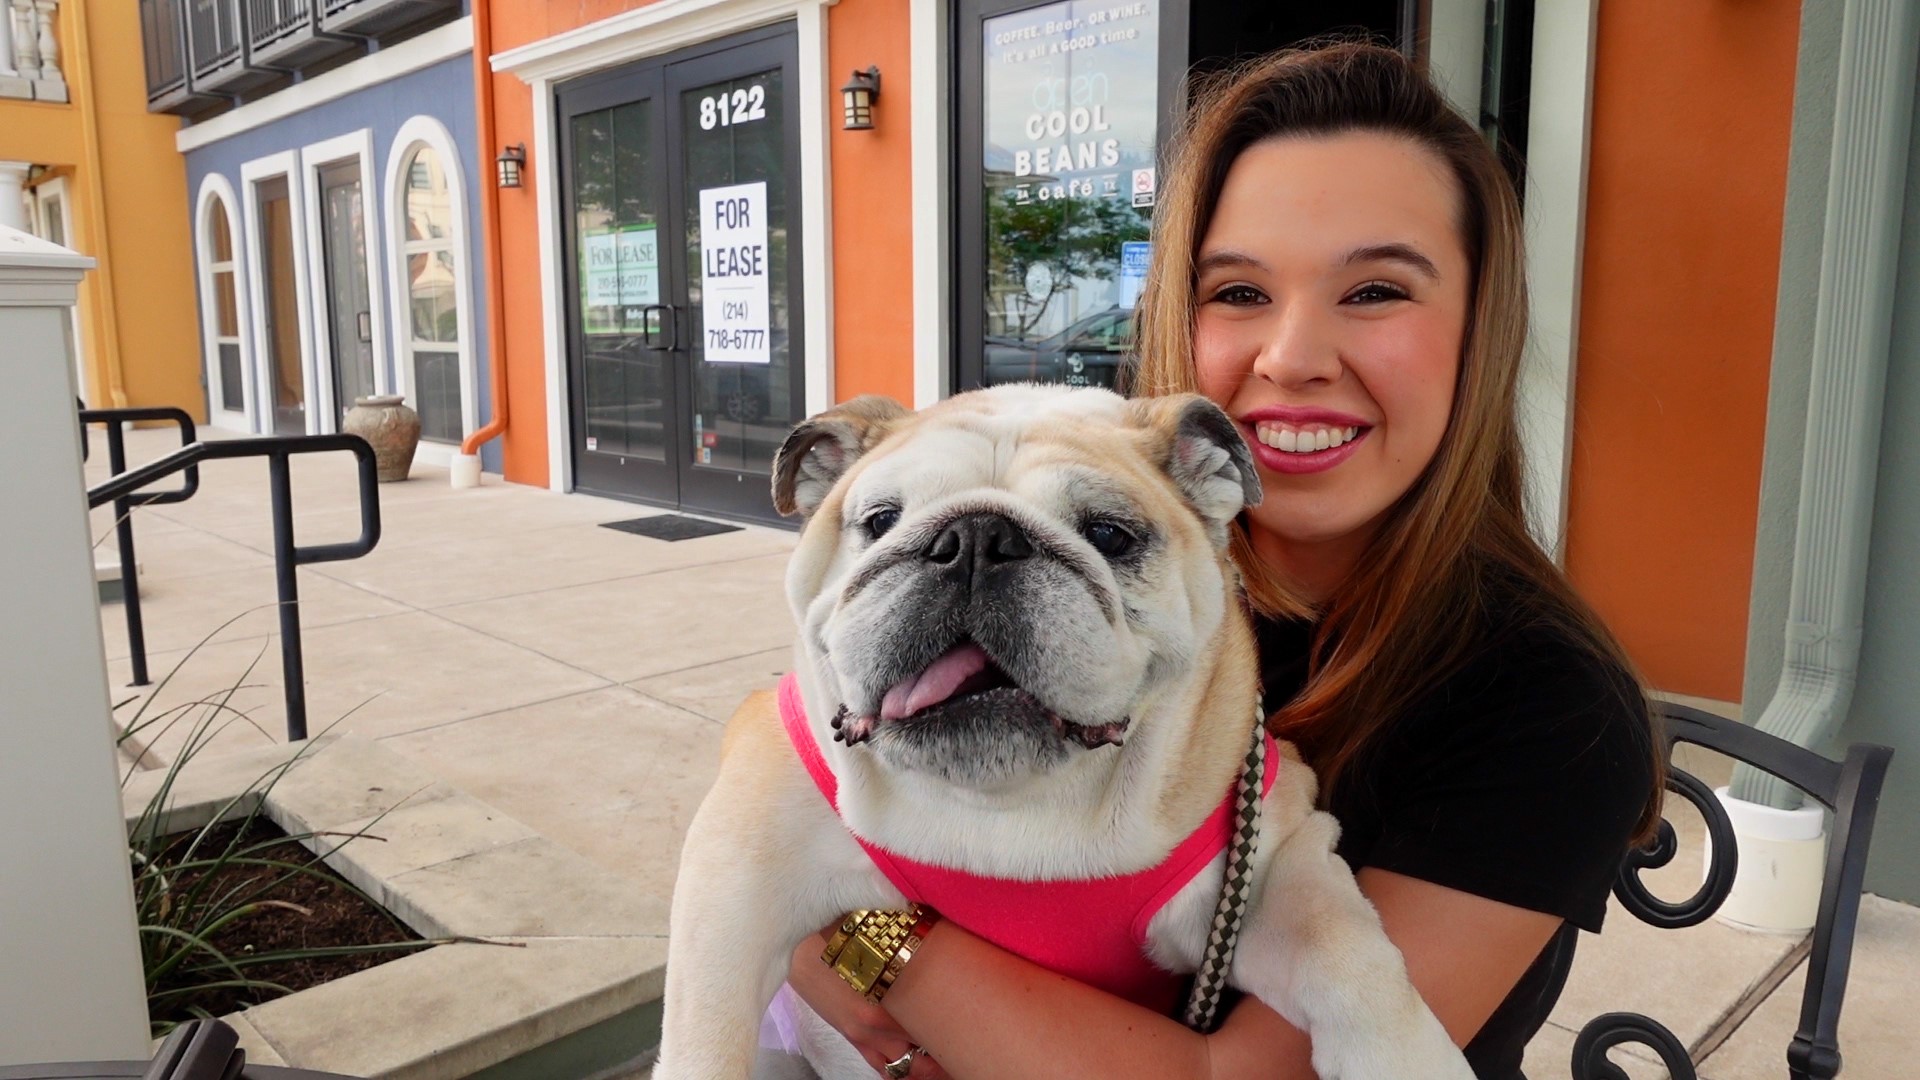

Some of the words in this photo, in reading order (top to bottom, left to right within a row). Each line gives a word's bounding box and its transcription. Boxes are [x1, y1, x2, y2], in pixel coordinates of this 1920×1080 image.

[1088, 11, 1106, 25] OR
[1029, 44, 1045, 59] all
[1061, 35, 1096, 52] GOOD
[1101, 28, 1136, 44] time
[700, 85, 766, 130] 8122
[1026, 105, 1109, 140] COOL
[1015, 138, 1119, 176] BEANS
[1038, 178, 1093, 200] café
[1103, 181, 1116, 190] TX
[715, 198, 750, 230] FOR
[617, 243, 655, 264] LEASE
[707, 245, 762, 278] LEASE
[723, 300, 748, 321] (214)
[709, 329, 764, 349] 718-6777
